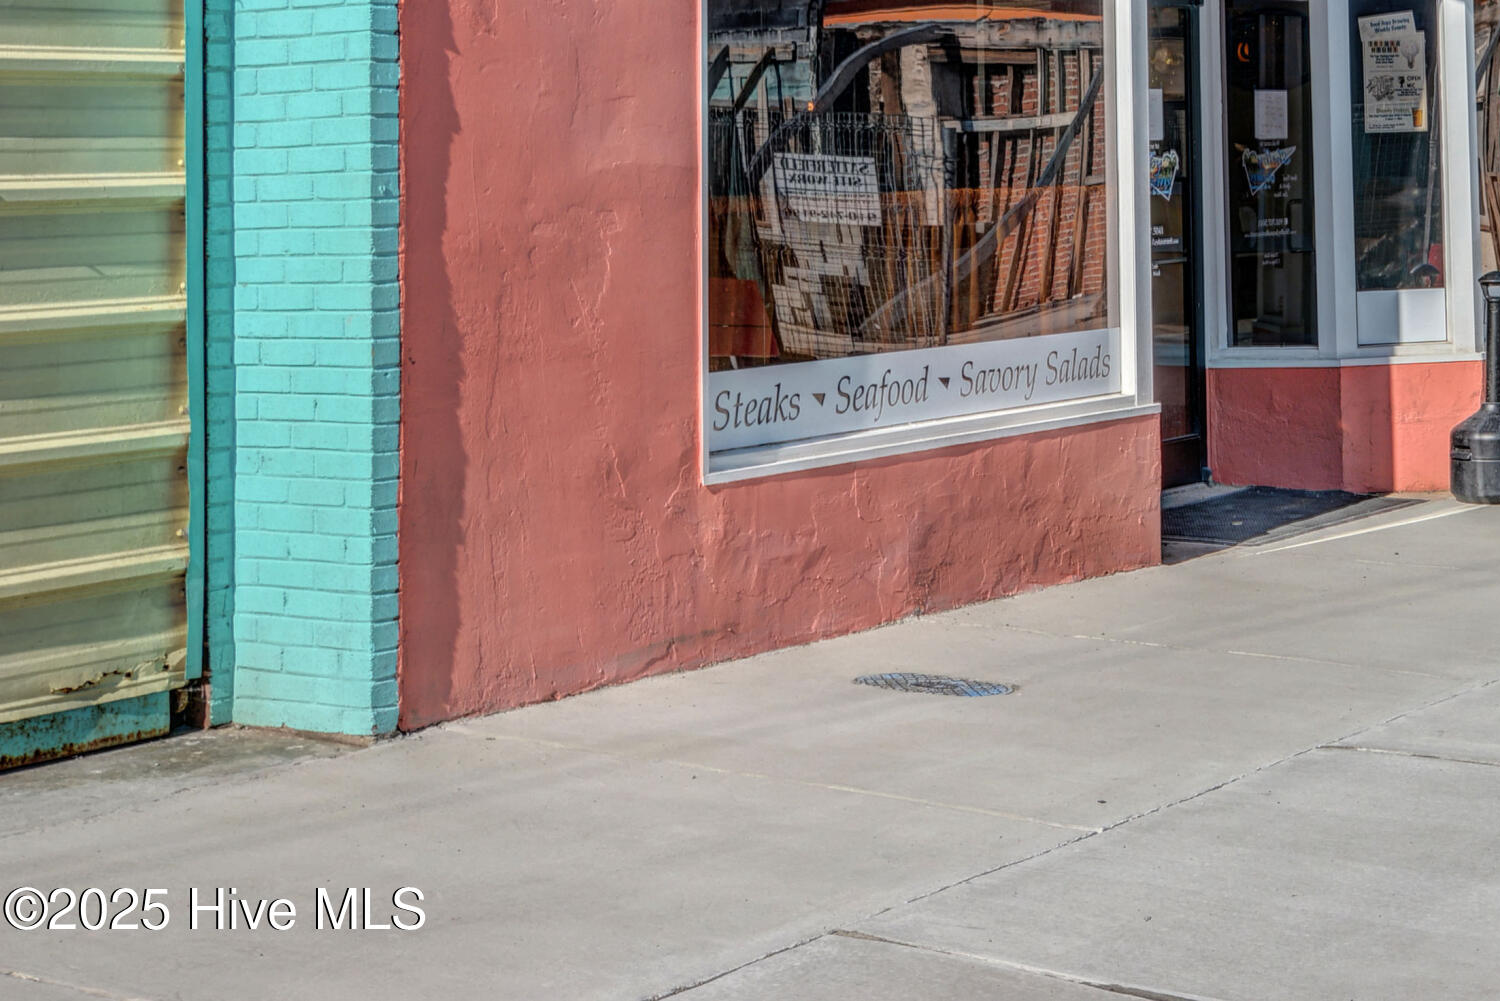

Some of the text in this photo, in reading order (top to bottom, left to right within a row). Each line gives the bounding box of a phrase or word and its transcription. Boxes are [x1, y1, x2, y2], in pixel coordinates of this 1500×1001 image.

[712, 343, 1112, 433] Steaks Seafood Savory Salads
